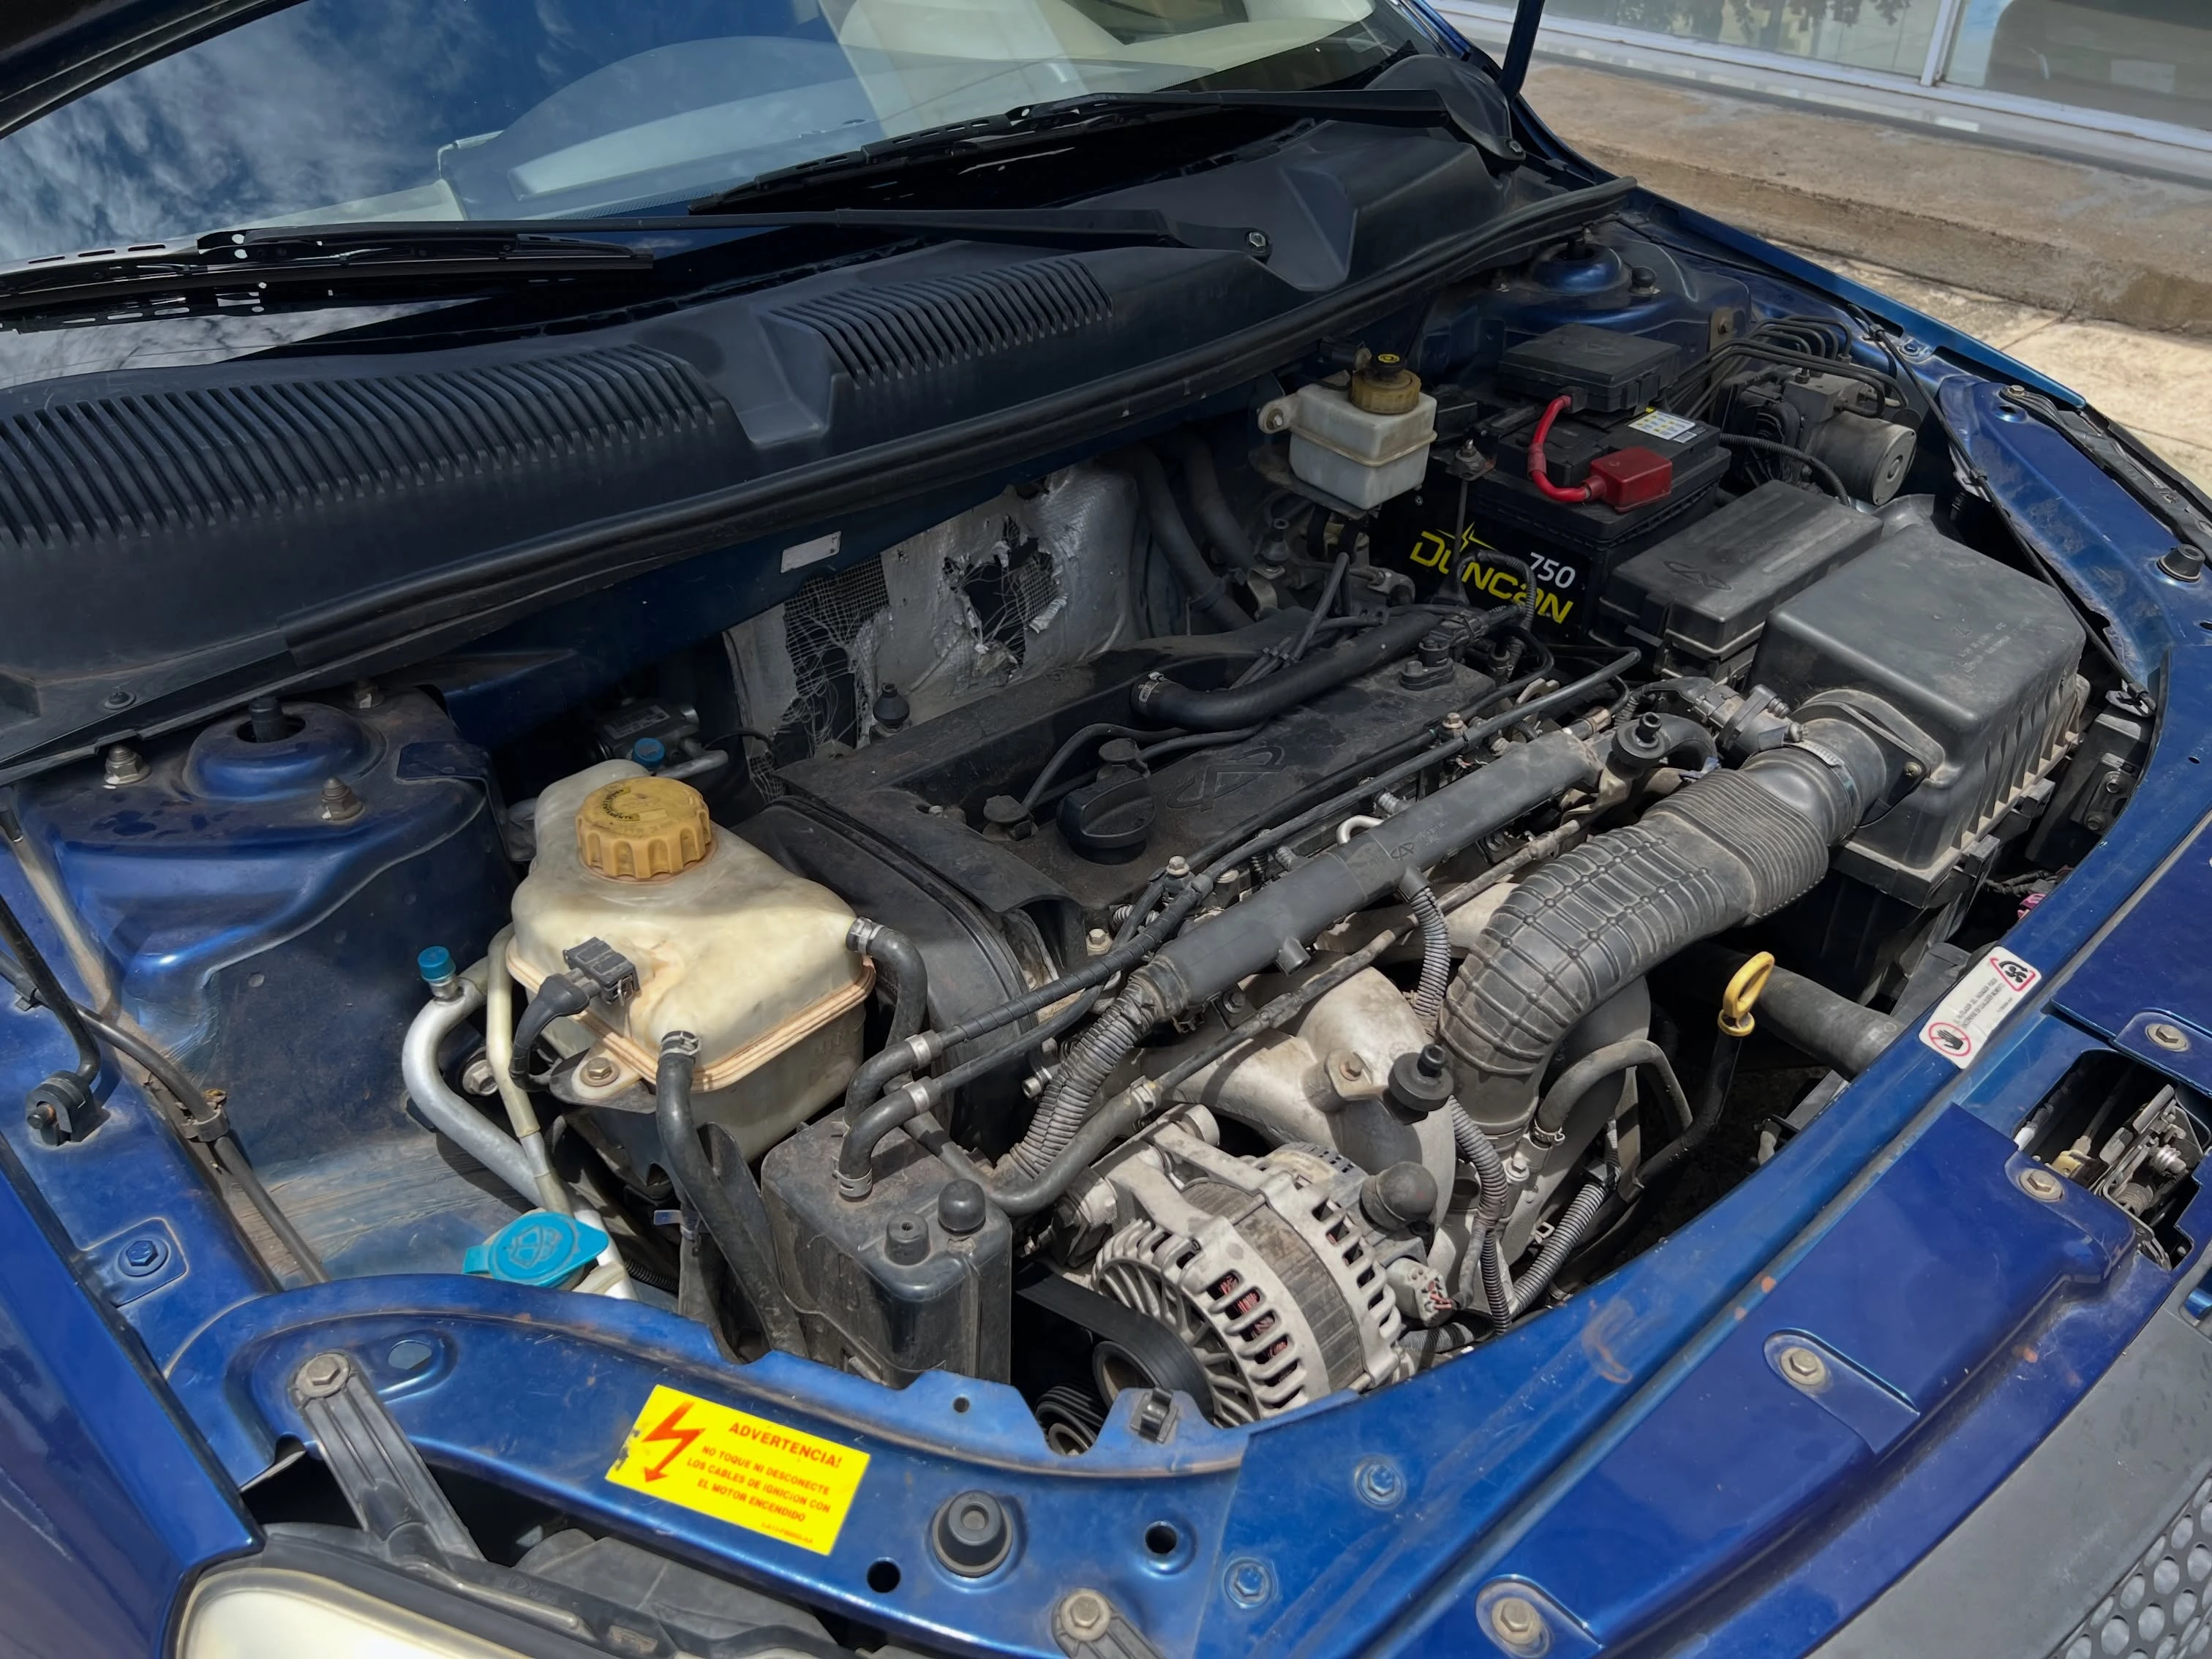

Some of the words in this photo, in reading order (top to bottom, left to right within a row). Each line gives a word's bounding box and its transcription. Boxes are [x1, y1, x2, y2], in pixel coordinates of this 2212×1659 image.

[1530, 552, 1576, 589] 750
[729, 1422, 843, 1469] ADVERTENCIA!
[687, 1457, 707, 1471] LOS
[707, 1464, 745, 1484] CABLES
[747, 1478, 761, 1489] DE
[809, 1500, 831, 1513] CON
[701, 1445, 717, 1456] NO
[718, 1451, 752, 1469] TOQUE
[753, 1462, 764, 1473] NI
[765, 1467, 830, 1496] DESCONECTE
[697, 1478, 710, 1489] EL
[712, 1483, 748, 1502] MOTOR
[748, 1495, 806, 1522] ENCENDIDO
